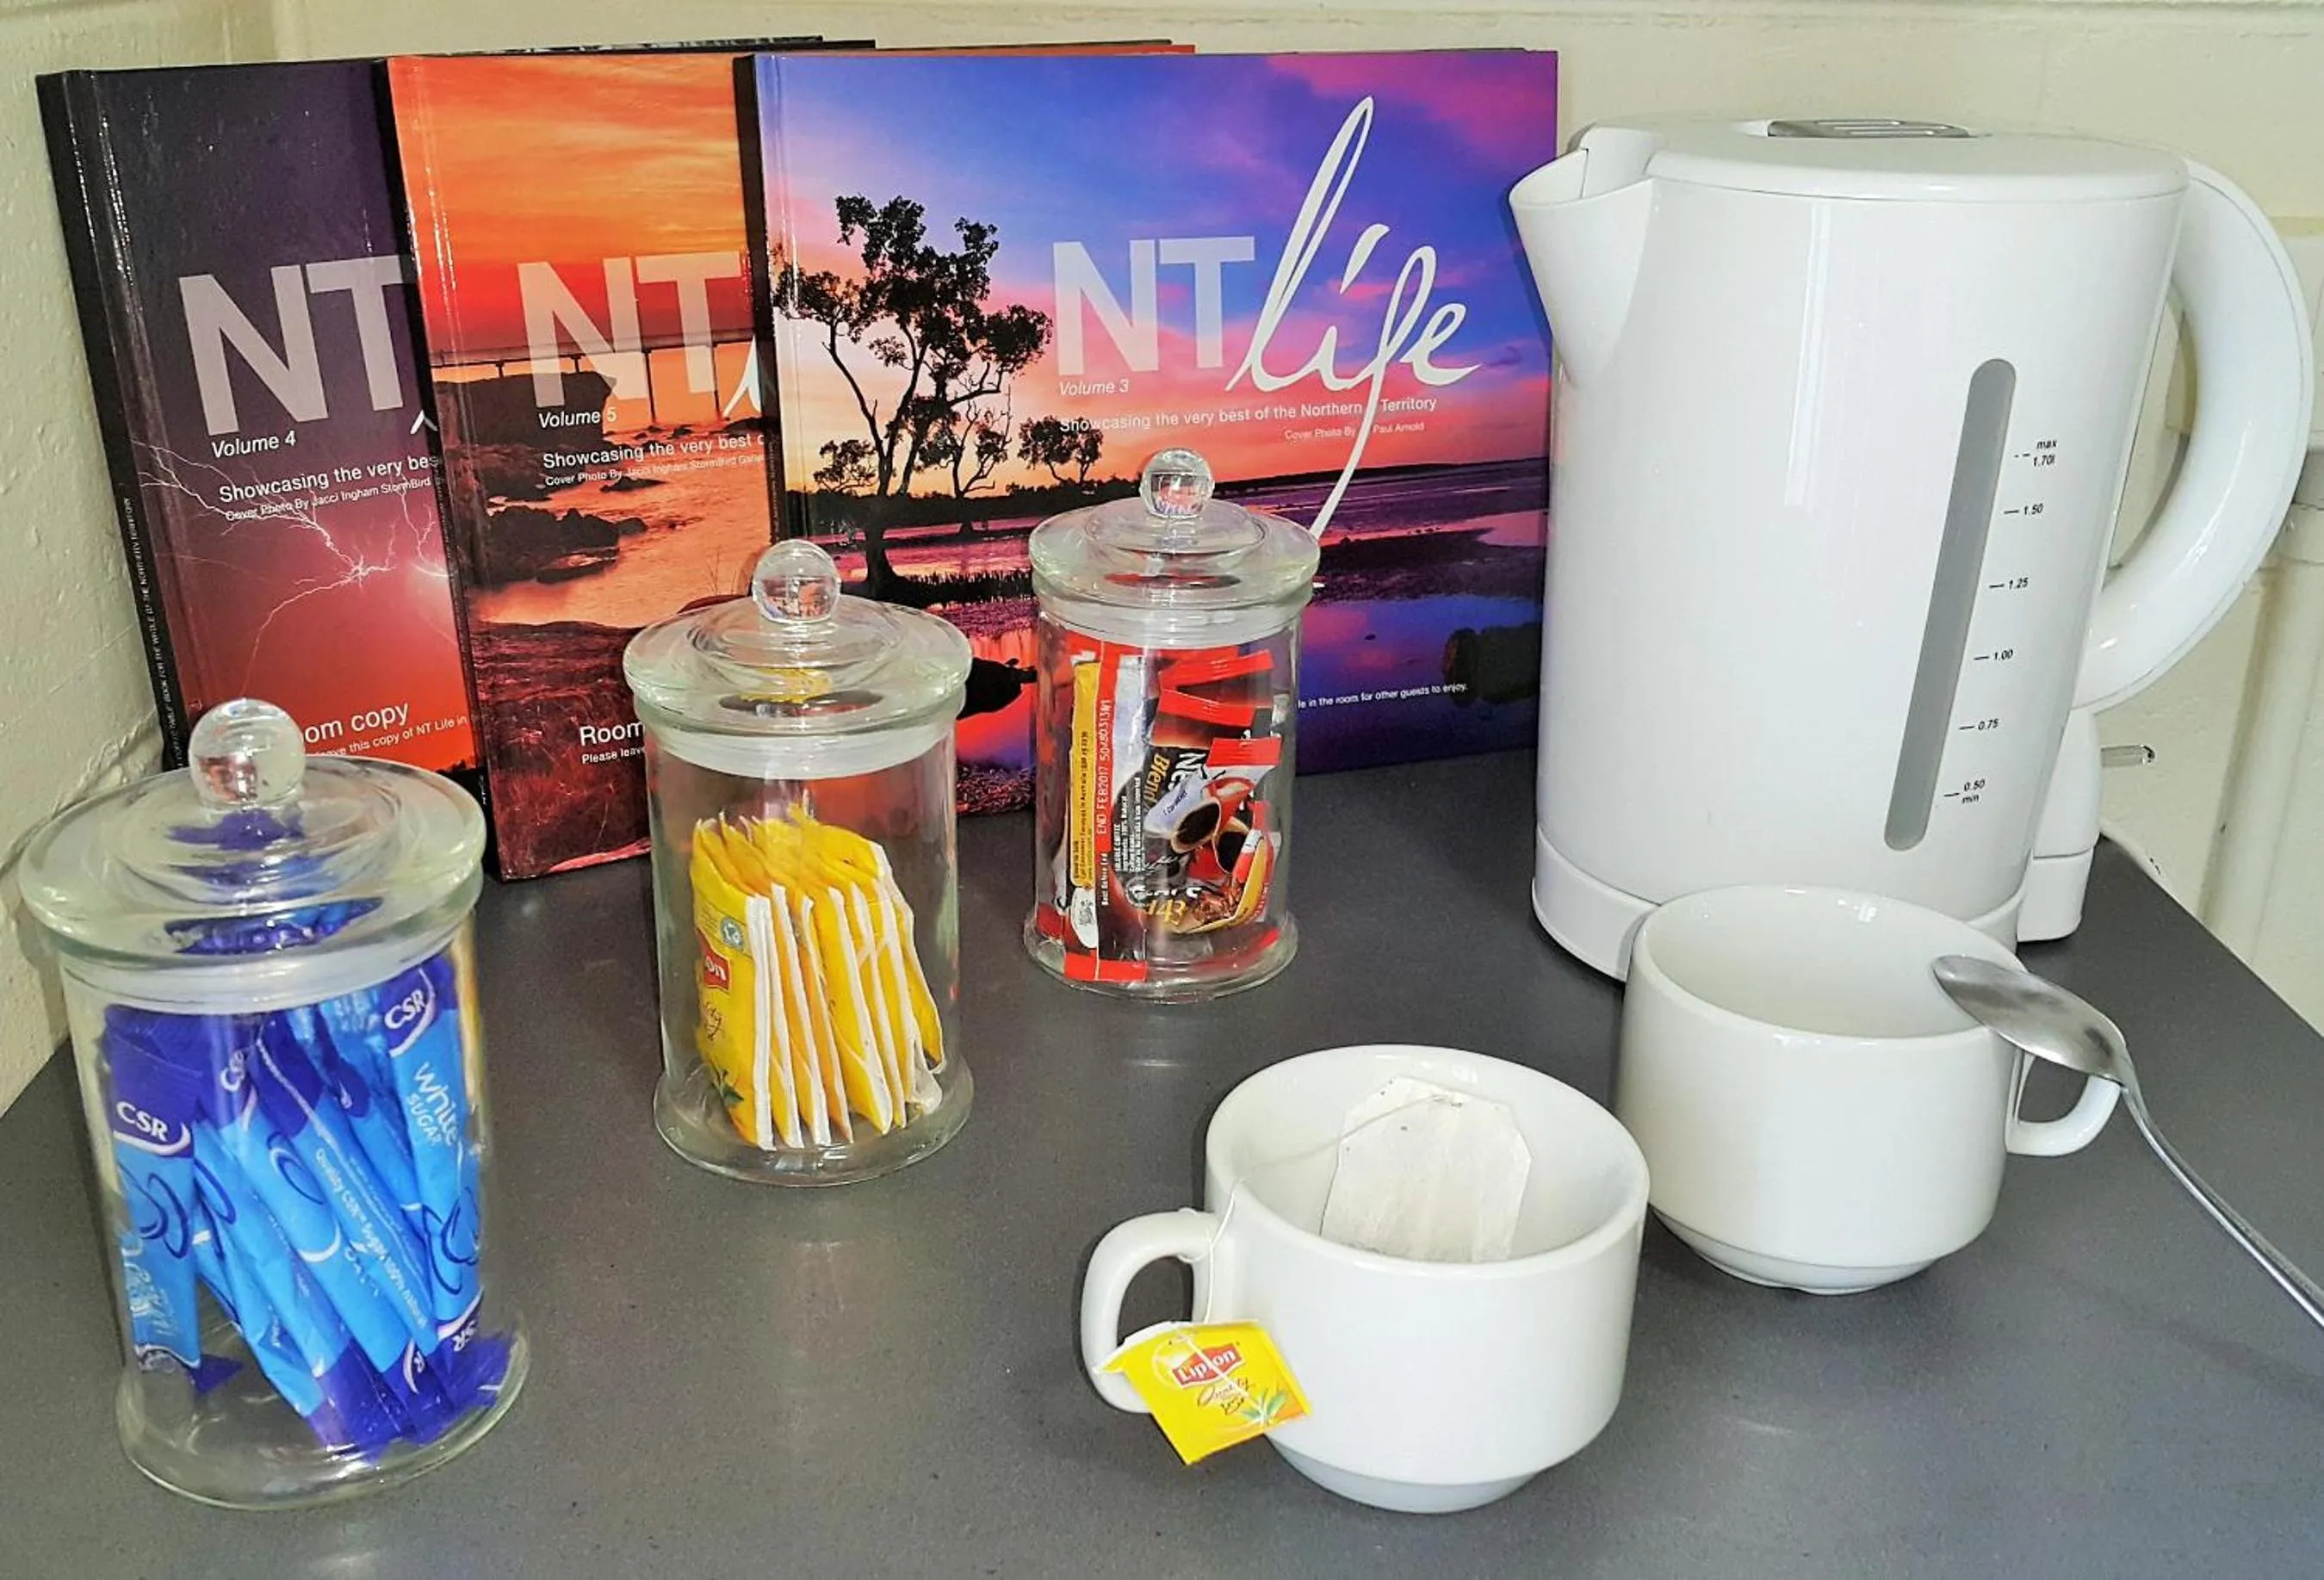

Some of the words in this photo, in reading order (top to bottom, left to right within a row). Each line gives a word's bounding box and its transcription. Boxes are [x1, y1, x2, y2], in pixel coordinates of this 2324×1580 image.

[1053, 235, 1255, 376] NT
[1225, 96, 1481, 538] life
[517, 251, 741, 407] NT
[179, 256, 403, 436] NT
[1059, 381, 1115, 396] Volume
[1119, 378, 1130, 393] 3
[538, 411, 600, 428] Volume
[607, 406, 617, 422] 5
[1060, 416, 1150, 432] Showcasing
[1156, 413, 1179, 425] the
[1184, 412, 1214, 427] very
[1219, 409, 1250, 422] best
[1255, 406, 1270, 420] of
[1274, 405, 1296, 418] the
[1301, 403, 1362, 417] Northern
[1381, 397, 1437, 412] Territory
[1344, 426, 1357, 437] By
[212, 436, 279, 458] Volume
[285, 430, 296, 446] 4
[543, 446, 644, 468] Showcasing
[649, 443, 675, 455] the
[680, 440, 712, 455] very
[718, 433, 751, 449] best
[2036, 440, 2057, 449] max
[220, 472, 329, 502] Showcasing
[334, 467, 362, 482] the
[367, 461, 402, 478] very
[545, 475, 575, 486] Cover
[578, 471, 607, 482] Photo
[294, 498, 309, 511] By
[2023, 504, 2043, 515] 1.50
[2009, 578, 2029, 589] 1.25
[1993, 649, 2013, 660] 1.00
[1309, 699, 1317, 708] in
[1318, 697, 1334, 706] the
[1336, 695, 1359, 704] room
[1361, 692, 1373, 702] for
[1375, 691, 1398, 700] other
[305, 720, 343, 743] om
[351, 703, 409, 732] copy
[349, 740, 370, 753] this
[373, 734, 400, 749] copy
[403, 728, 414, 740] of
[416, 722, 431, 735] NT
[435, 718, 455, 731] Life
[457, 715, 468, 726] in
[579, 722, 645, 746] Room
[1978, 719, 1999, 730] 0.75
[582, 751, 617, 765] Please
[1963, 779, 1985, 790] 0.50
[1962, 794, 1980, 804] min
[1096, 815, 1108, 833] END
[385, 988, 426, 1030] CSR
[413, 1062, 457, 1146] white
[116, 1101, 168, 1142] CSR
[407, 1093, 443, 1146] SUGAR
[1178, 1349, 1236, 1382] Lipon
